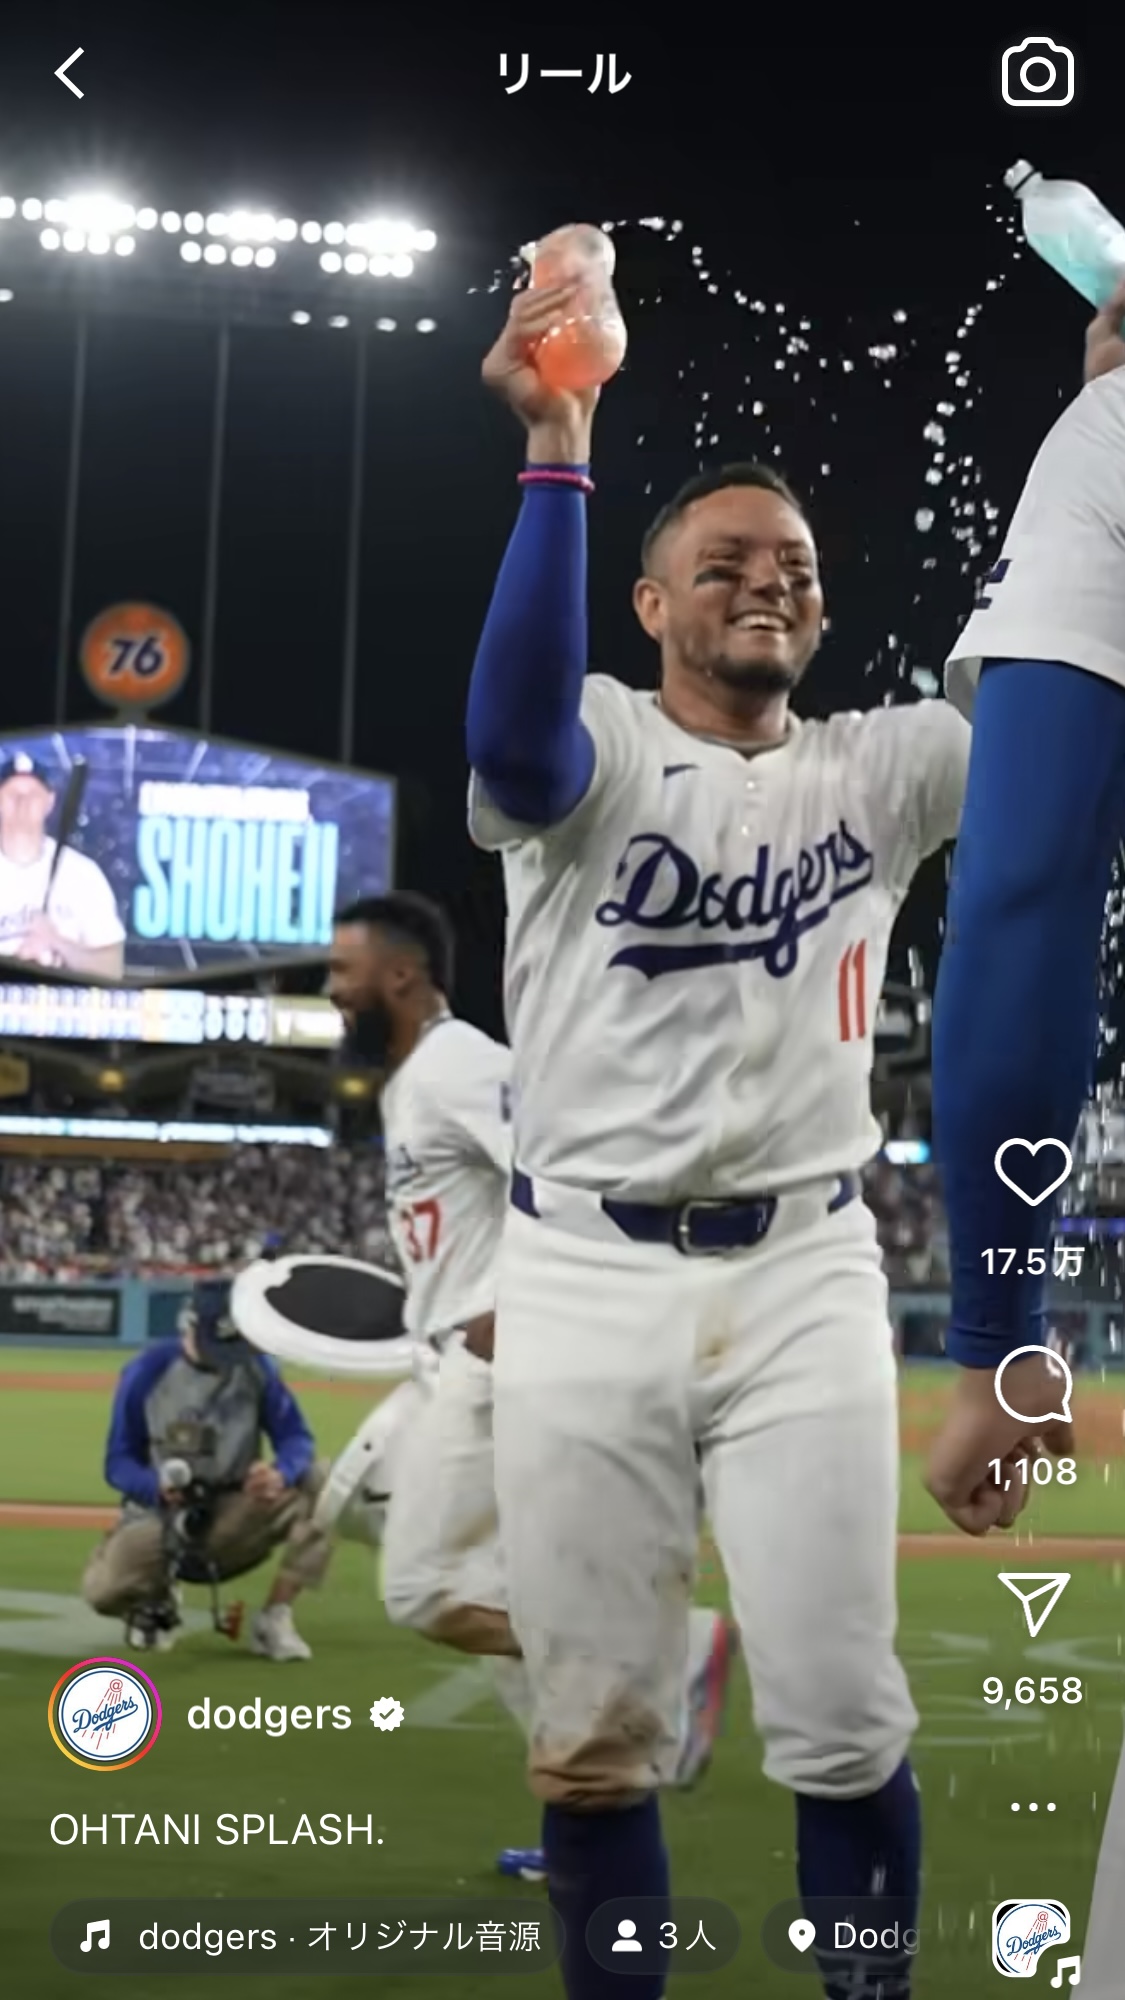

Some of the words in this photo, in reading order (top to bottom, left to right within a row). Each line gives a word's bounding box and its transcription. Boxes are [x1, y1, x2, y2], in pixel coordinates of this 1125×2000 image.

[109, 635, 163, 678] 76
[595, 820, 874, 980] Dodgers
[838, 939, 868, 1042] 11
